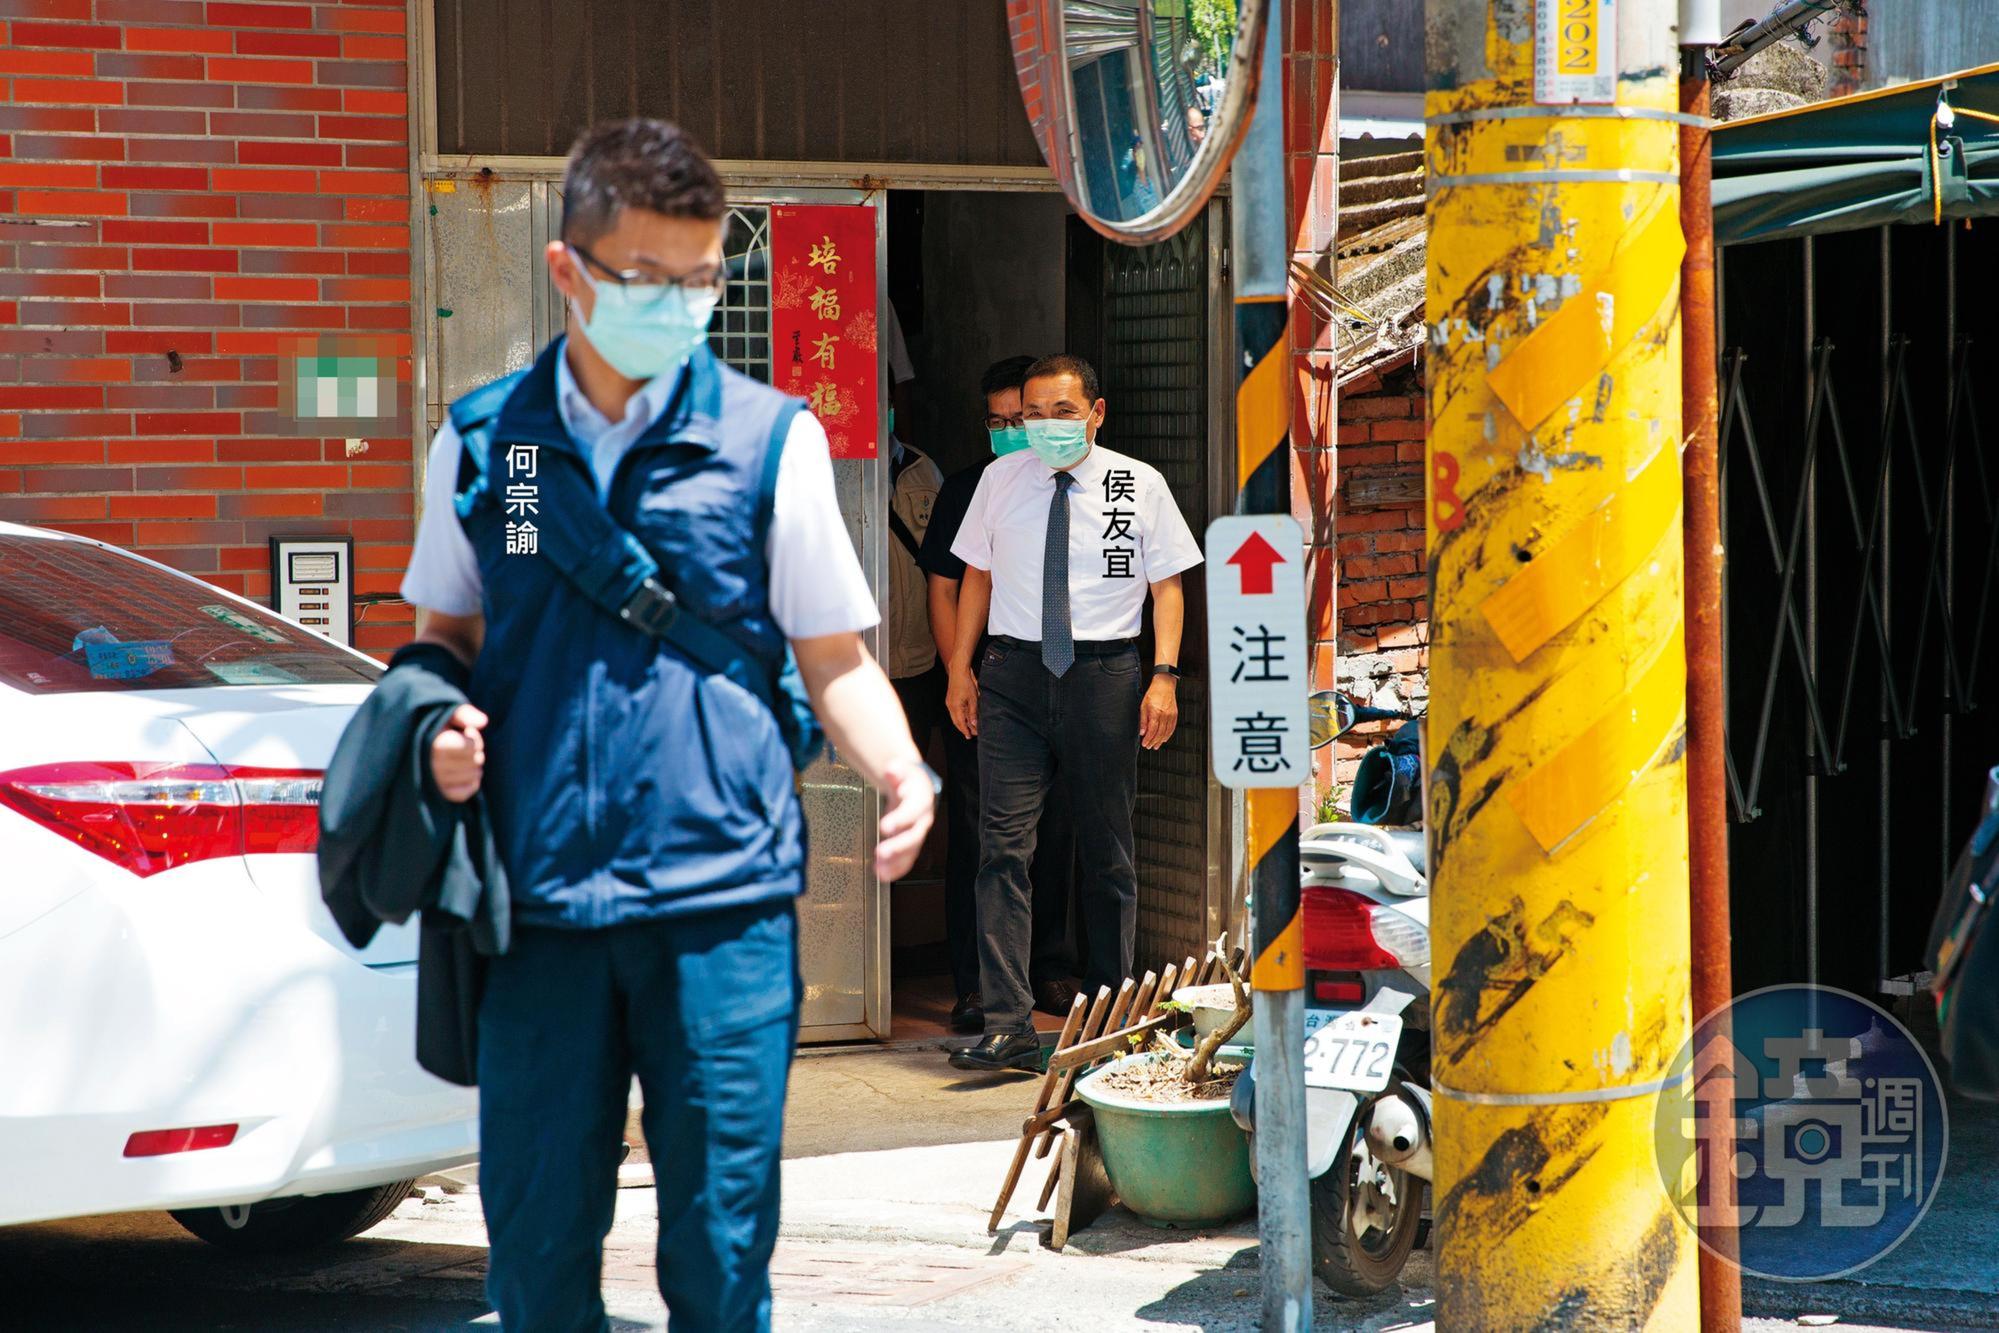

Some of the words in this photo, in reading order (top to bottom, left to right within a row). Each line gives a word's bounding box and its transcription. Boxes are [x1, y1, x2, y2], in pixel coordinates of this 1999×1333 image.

[808, 235, 841, 418] 培福有福
[1230, 624, 1291, 773] 注意
